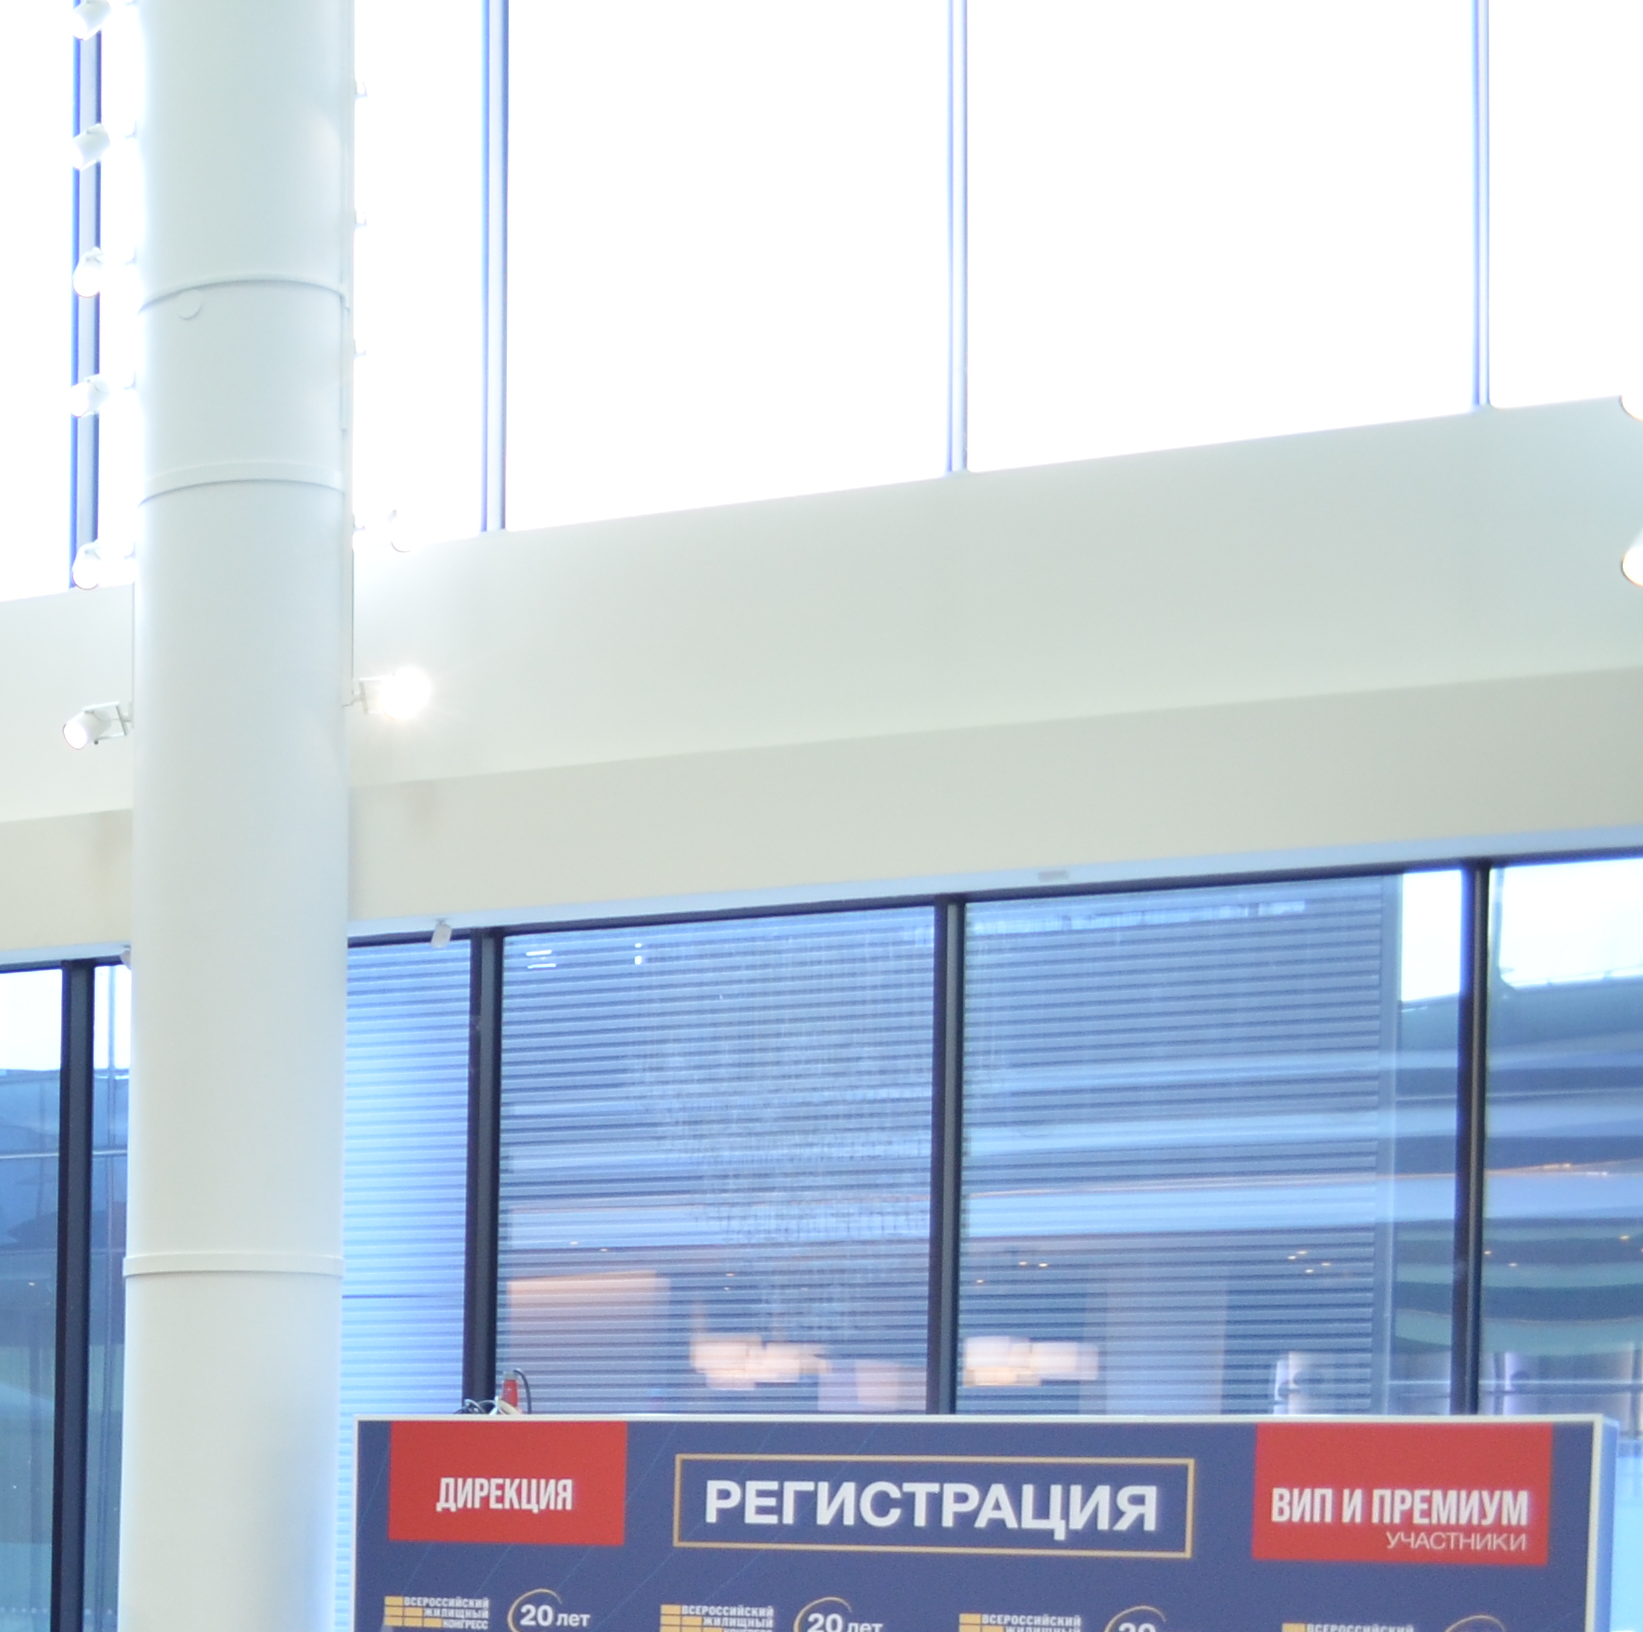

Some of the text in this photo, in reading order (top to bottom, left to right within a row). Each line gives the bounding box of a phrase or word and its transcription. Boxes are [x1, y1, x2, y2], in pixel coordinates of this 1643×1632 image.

[435, 1477, 573, 1514] ДИРЕКЦИЯ
[705, 1479, 1158, 1541] РЕГИСТРАЦИЯ
[1271, 1487, 1529, 1527] ВИП И ПРЕМИУМ
[1386, 1531, 1528, 1551] УЧАСТНИКИ
[403, 1596, 490, 1609] ВСЕРОССИЙСКИЙ
[423, 1607, 489, 1619] ЖИЛИЩНЫЙ
[520, 1604, 591, 1627] 20 лет
[681, 1604, 774, 1617] ВСЕРОССИЙСКИЙ
[442, 1618, 489, 1630] КОНГРЕСС
[702, 1616, 774, 1628] ЖИЛИЩНЫЙ
[981, 1613, 1082, 1627] ВСЕРОССИЙСКИЙ
